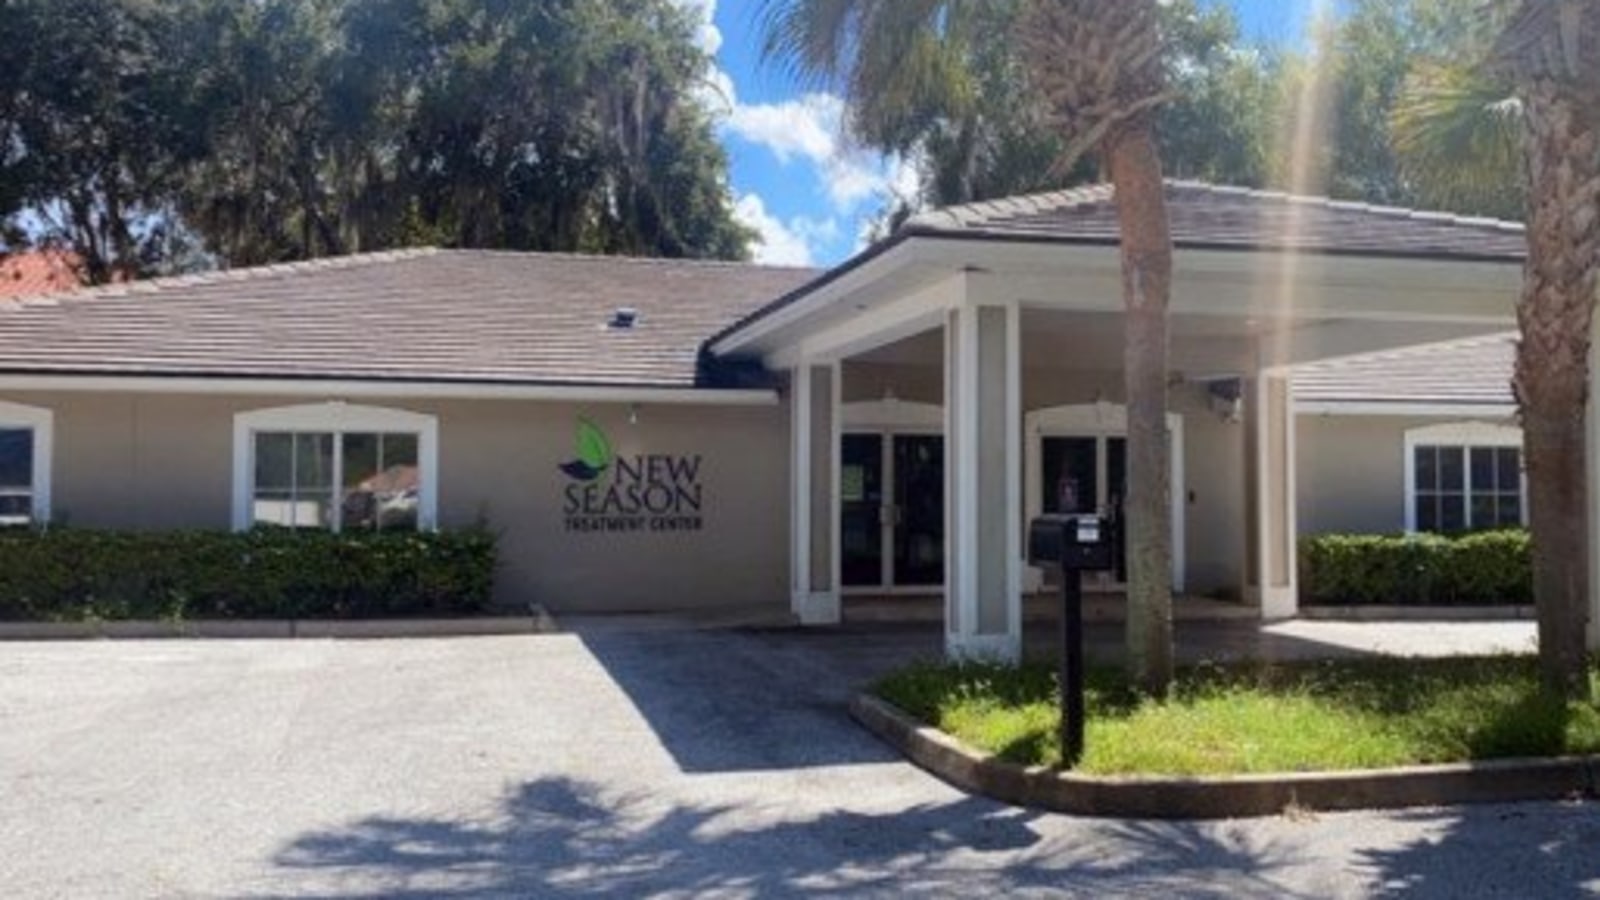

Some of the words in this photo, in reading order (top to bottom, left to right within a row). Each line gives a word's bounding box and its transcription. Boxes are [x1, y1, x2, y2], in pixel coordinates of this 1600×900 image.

[615, 455, 702, 484] NEW
[563, 483, 702, 514] SEASON
[565, 517, 646, 532] TREATMENT
[650, 517, 703, 532] CENTER
